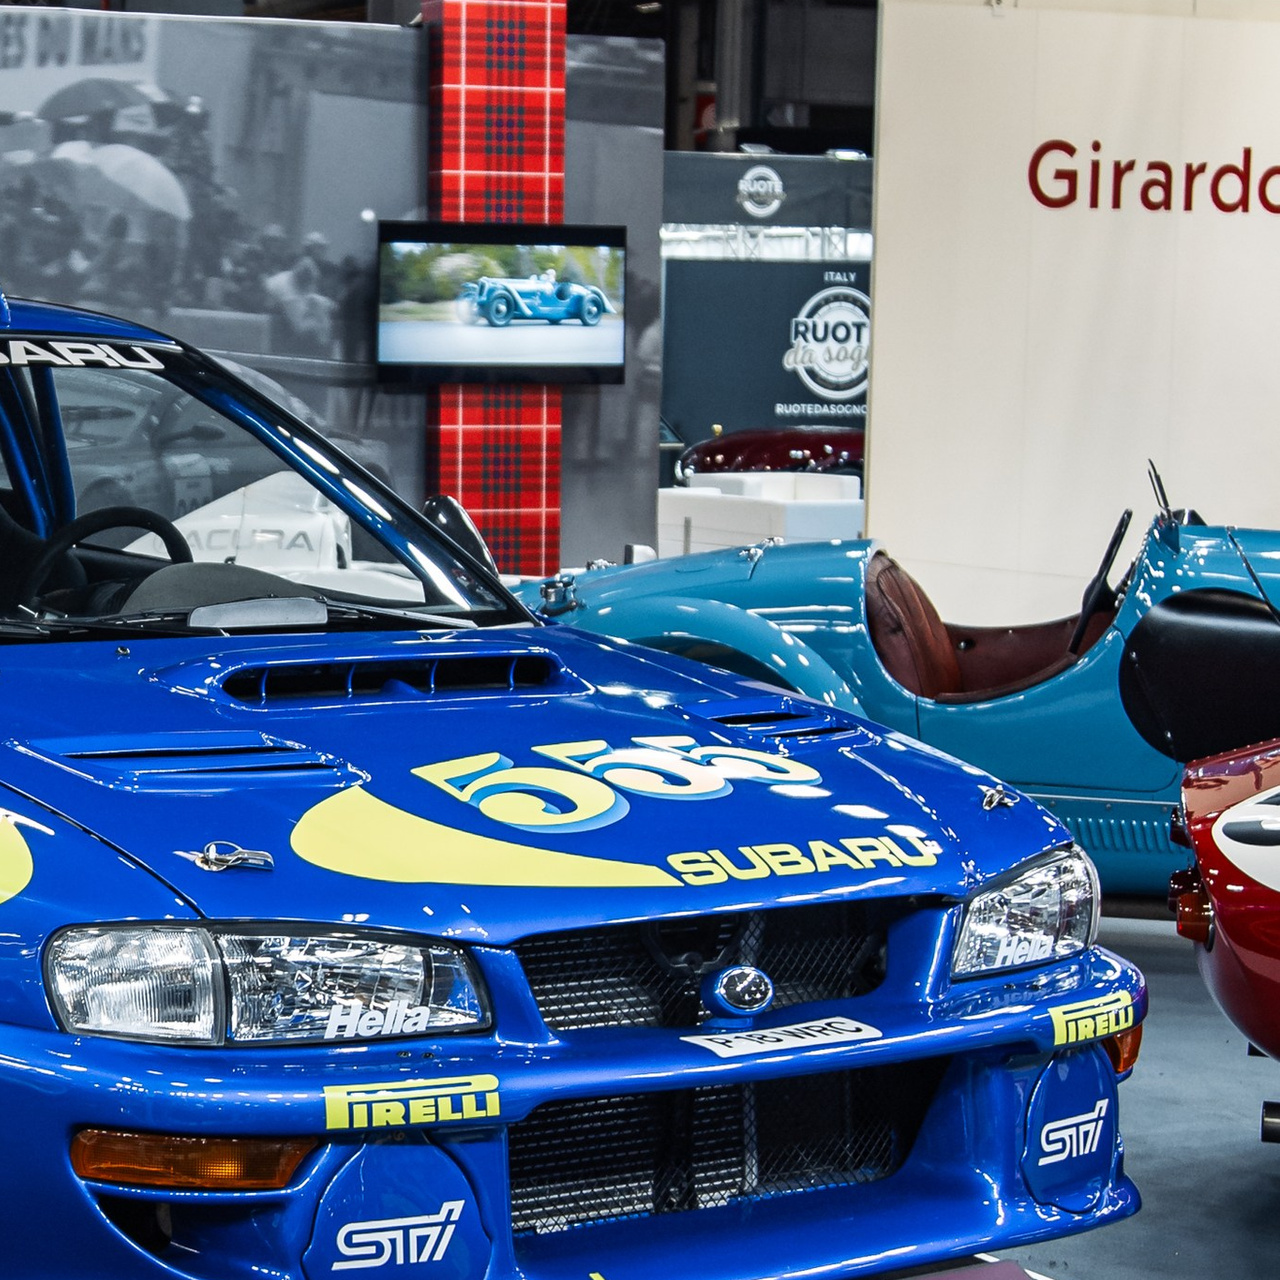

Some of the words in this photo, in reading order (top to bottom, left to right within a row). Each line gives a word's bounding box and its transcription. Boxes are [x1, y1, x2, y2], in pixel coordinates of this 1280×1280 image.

[824, 271, 857, 282] ITALY
[824, 345, 869, 370] sog
[410, 736, 819, 832] 555
[667, 834, 939, 886] SUBARU
[994, 935, 1055, 968] Hella
[324, 999, 431, 1040] Hella
[777, 1020, 864, 1040] WRC
[1047, 990, 1134, 1046] PIRELLI
[323, 1073, 501, 1130] PIRELLI
